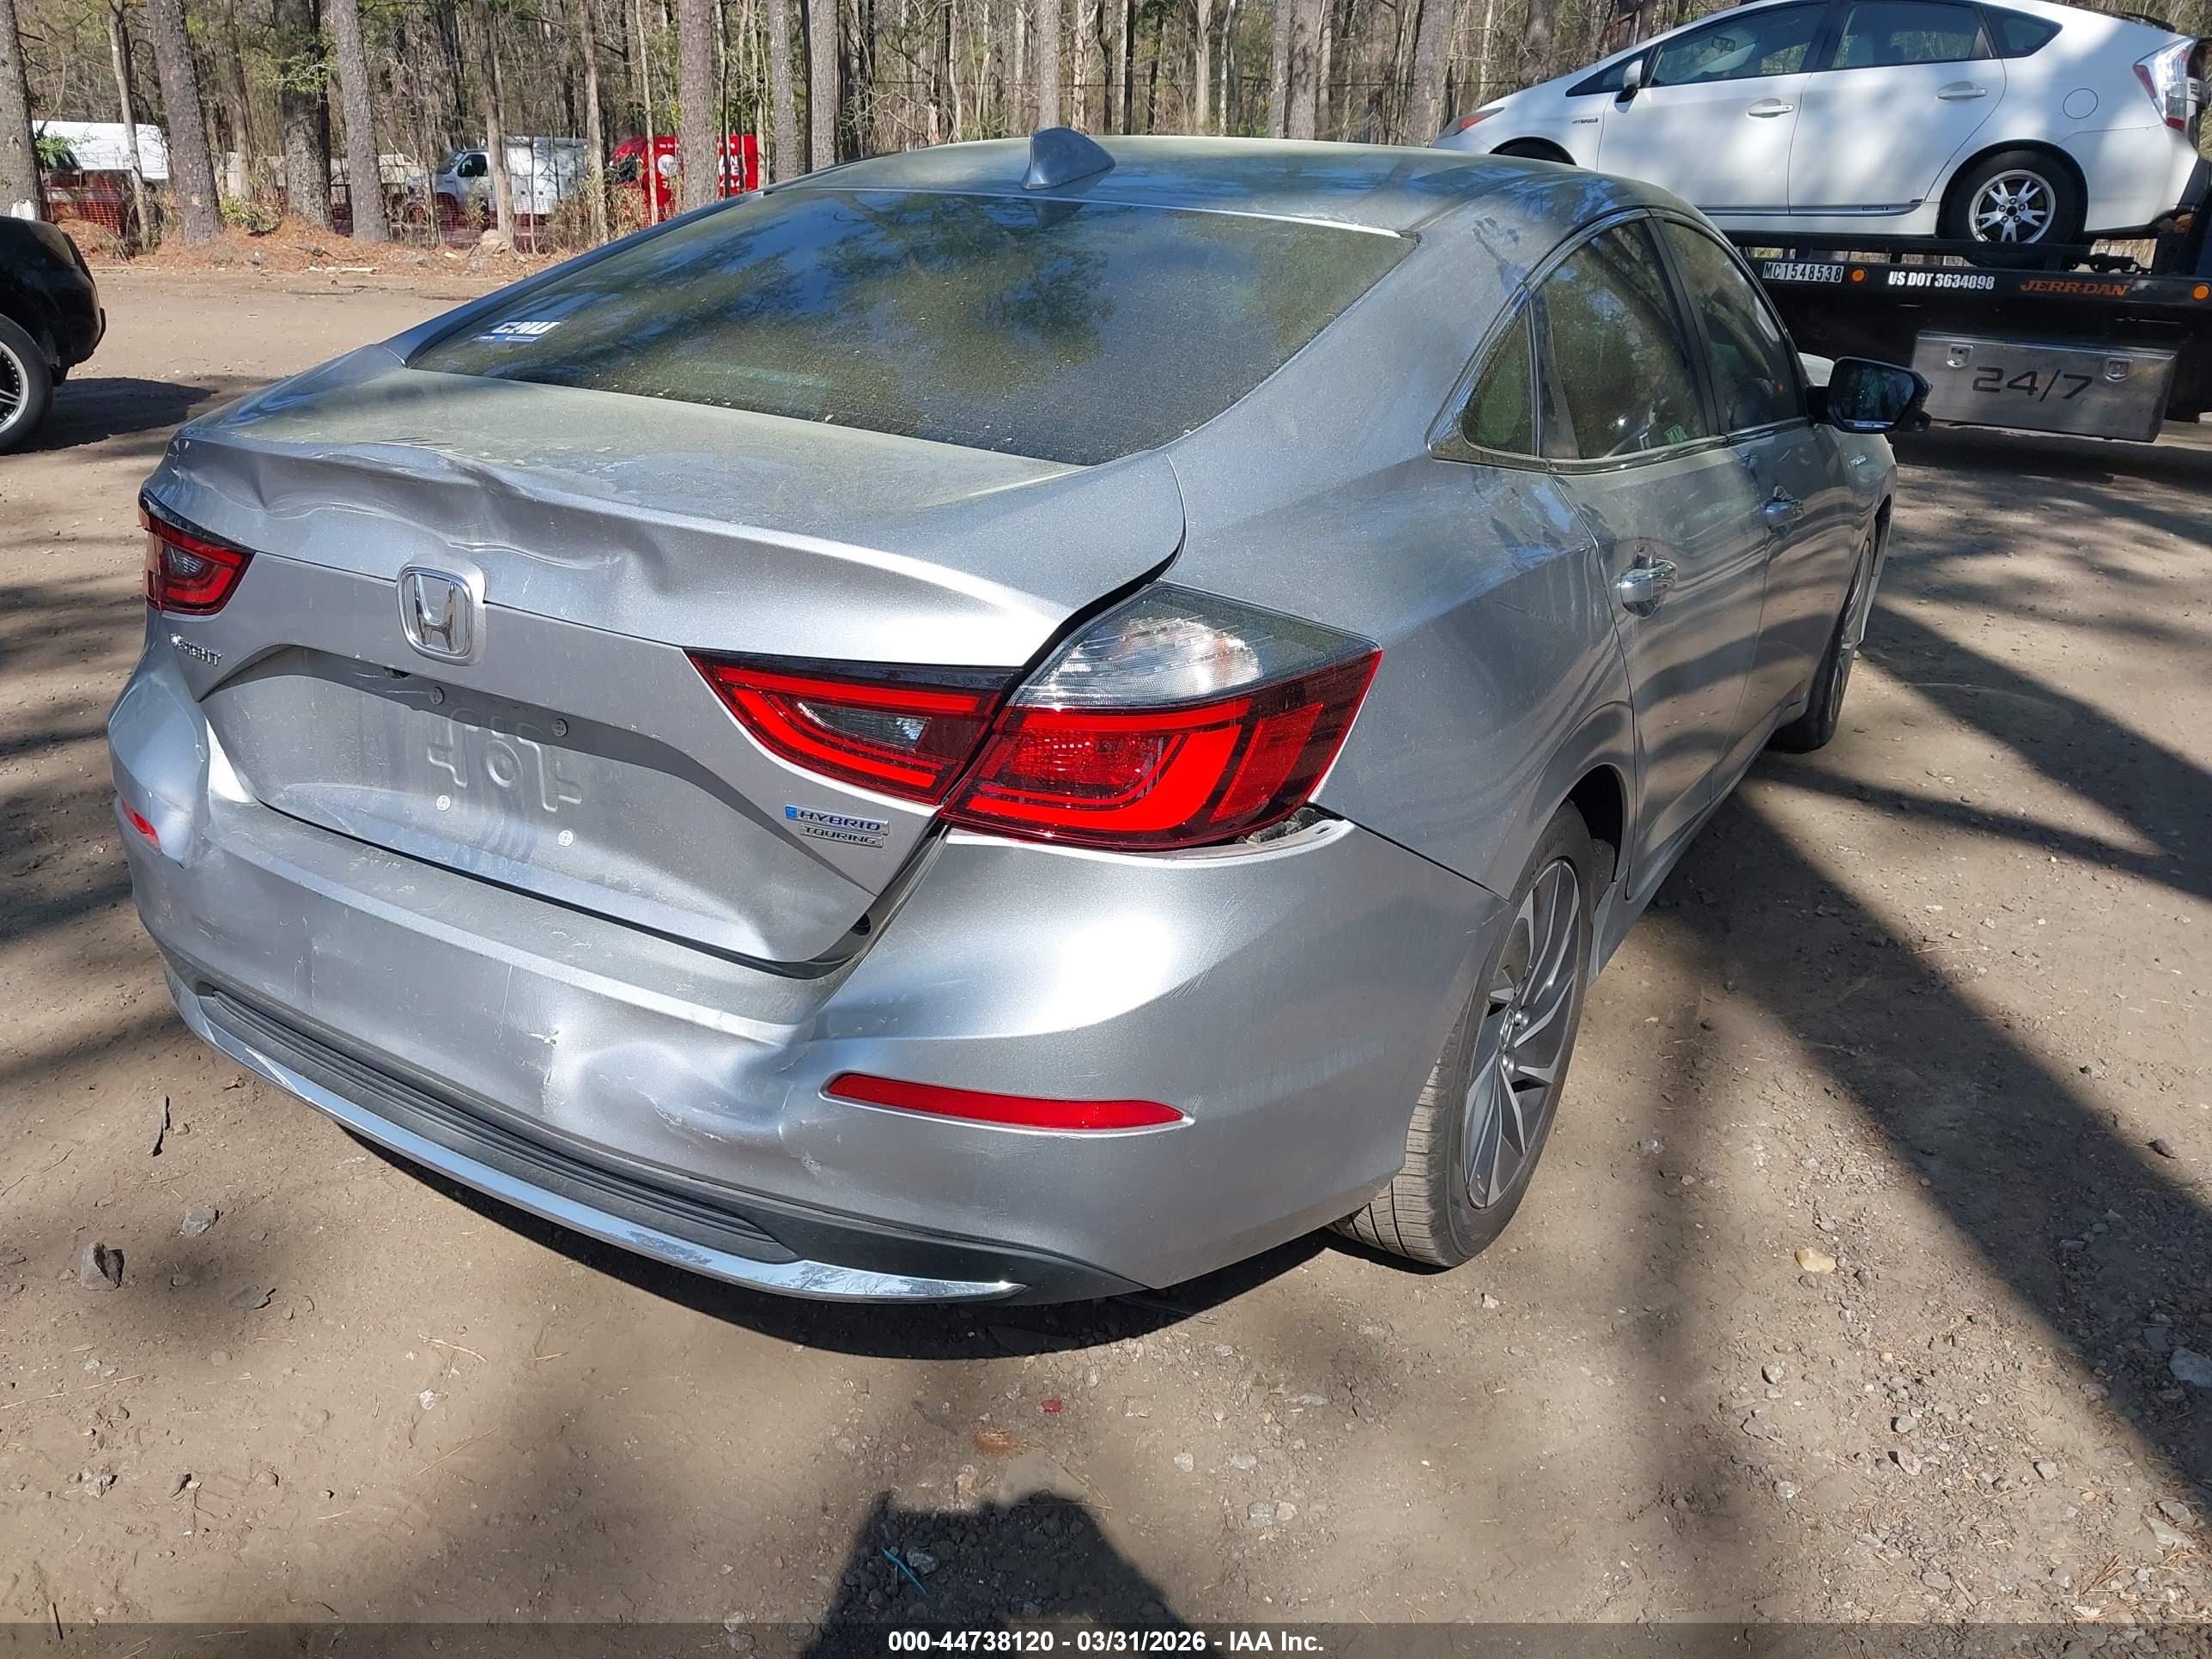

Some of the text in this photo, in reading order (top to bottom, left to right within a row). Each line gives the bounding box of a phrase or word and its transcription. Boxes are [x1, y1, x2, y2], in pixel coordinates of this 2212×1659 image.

[1764, 263, 1842, 282] MC1548538
[1888, 271, 1905, 286] US
[1906, 272, 1934, 287] DOT
[1972, 366, 2094, 403] 24/7
[799, 810, 881, 831] HYBRID
[804, 825, 877, 845] TOURING
